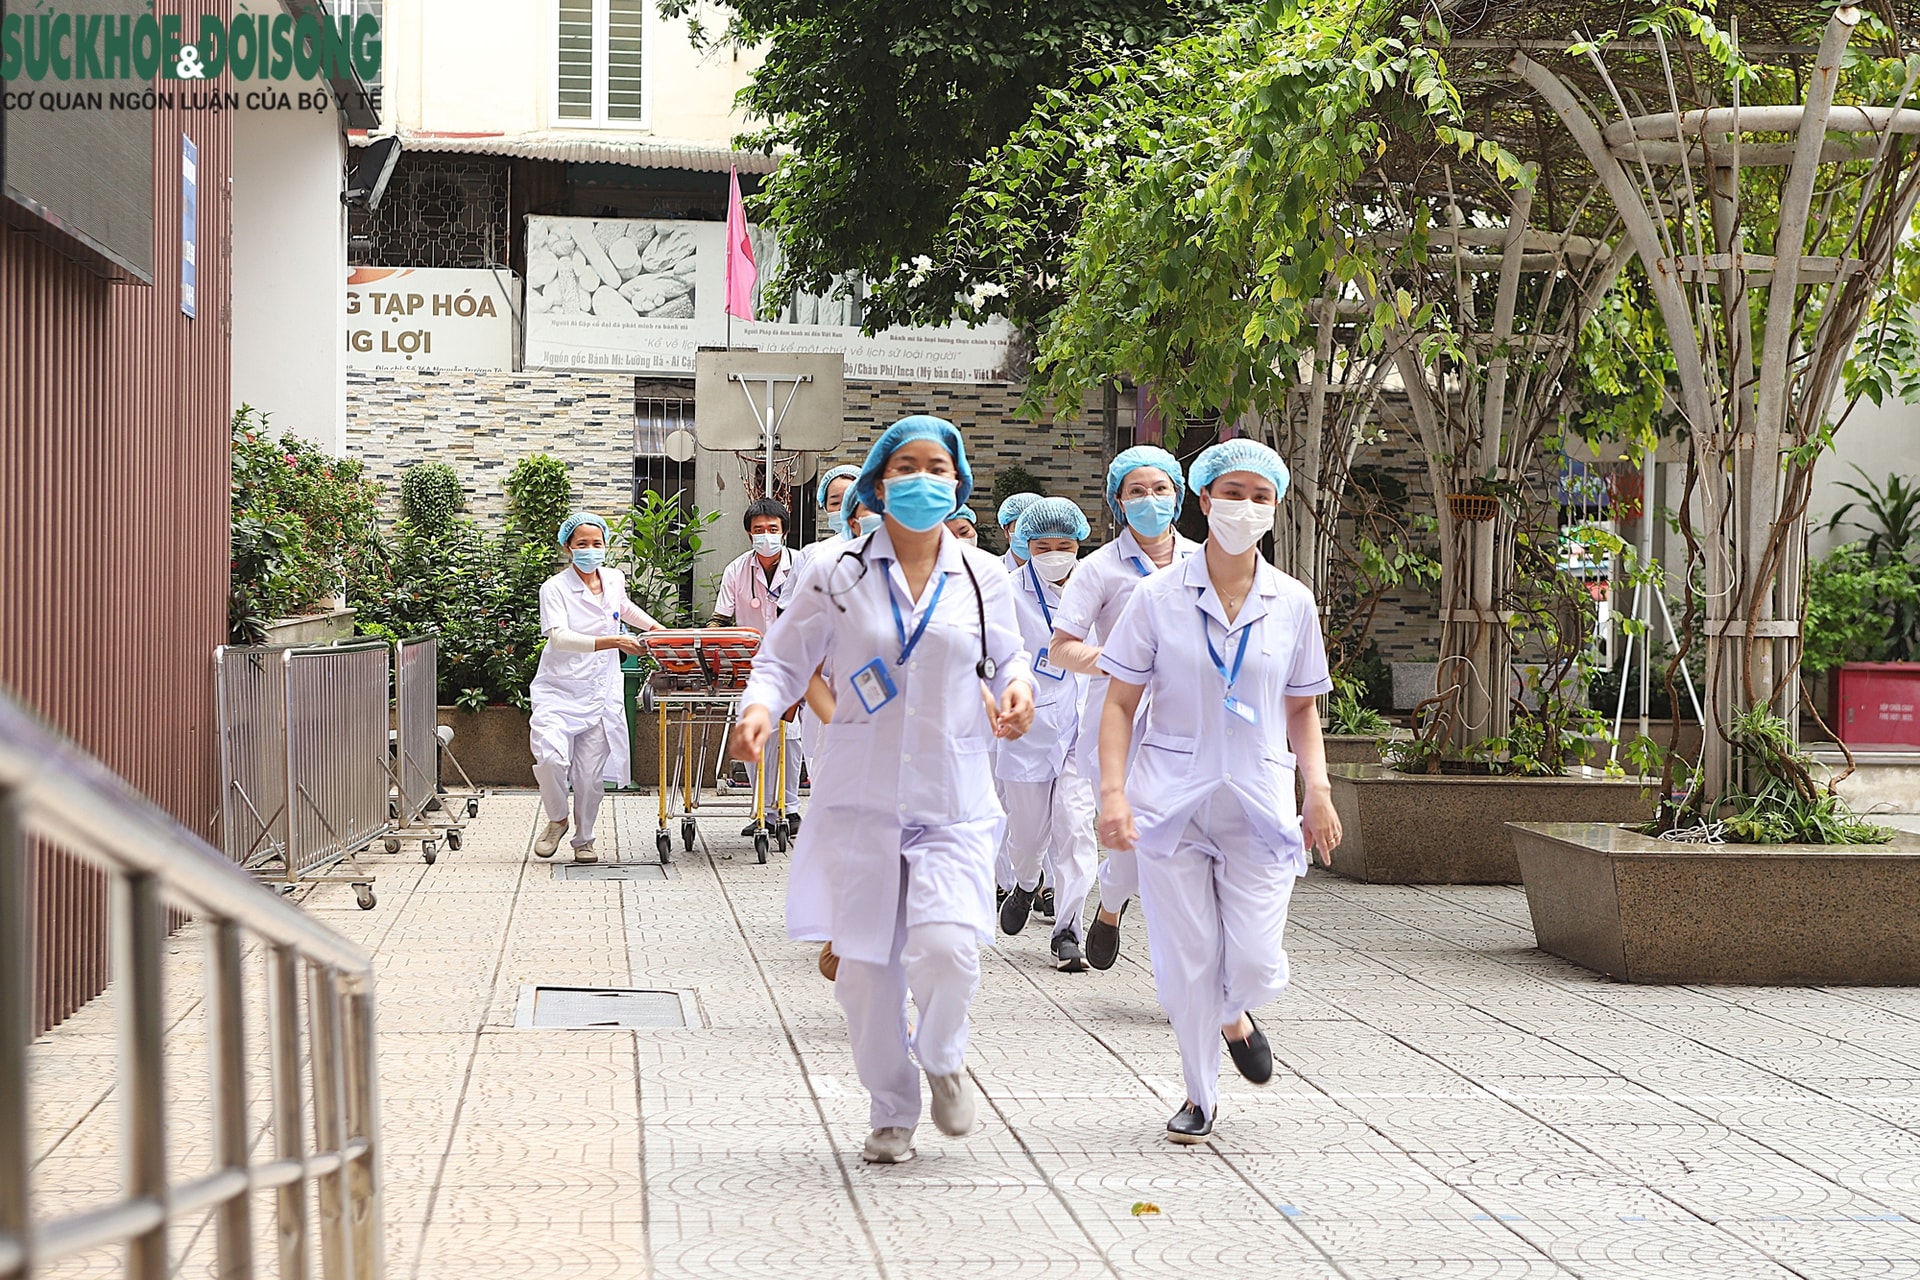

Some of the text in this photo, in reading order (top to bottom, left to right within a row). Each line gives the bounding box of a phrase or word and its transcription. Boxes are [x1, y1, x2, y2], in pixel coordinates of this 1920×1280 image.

[369, 293, 425, 323] TẠP
[432, 288, 497, 318] HÓA
[382, 330, 431, 361] LỢI
[588, 352, 609, 365] Bánh
